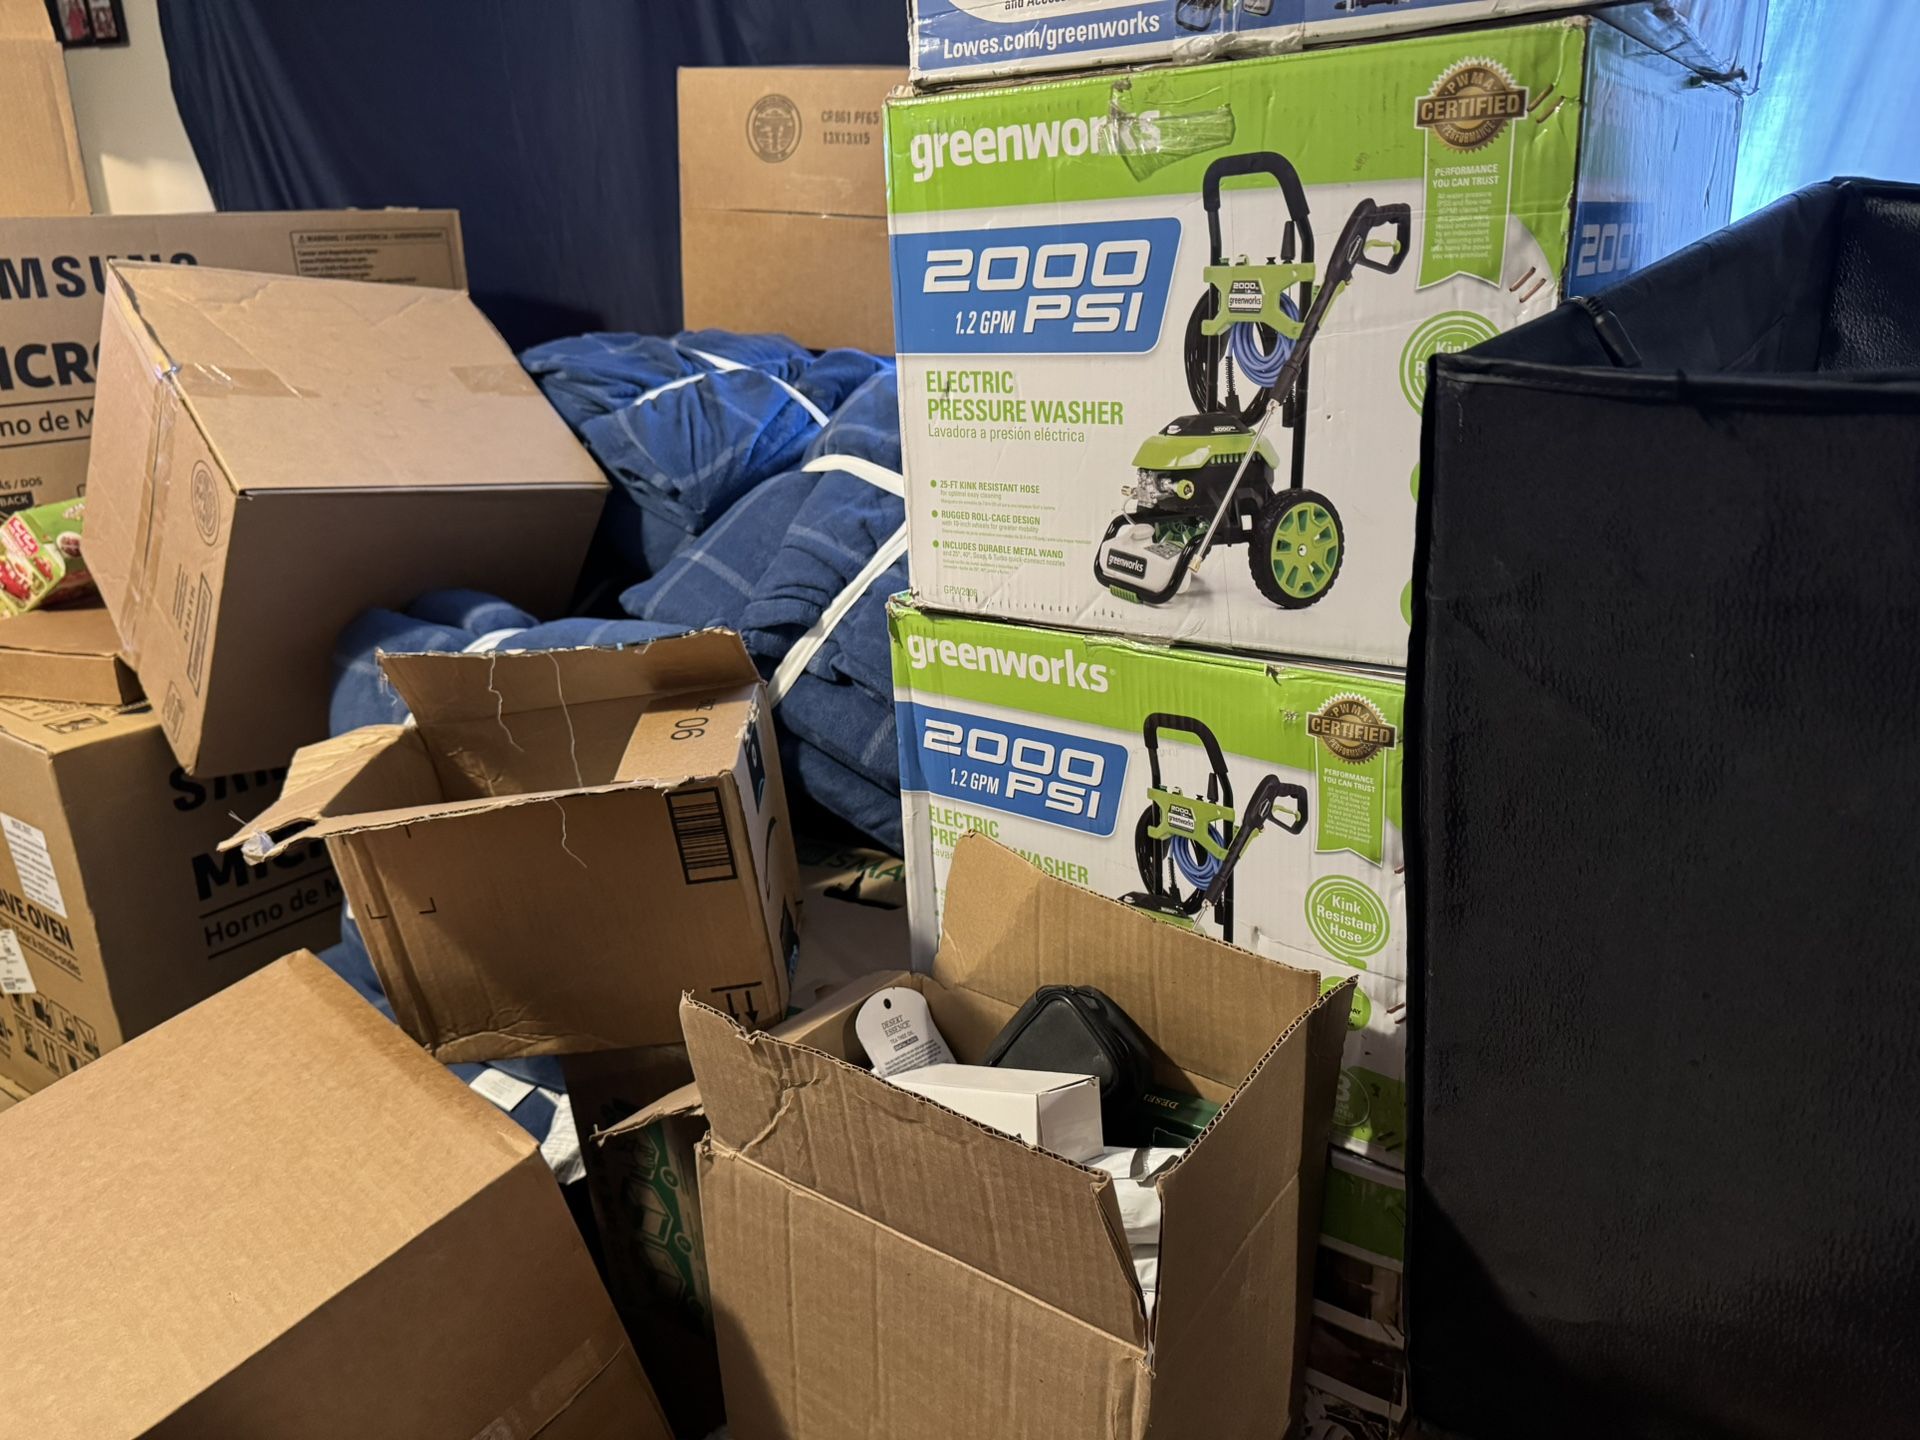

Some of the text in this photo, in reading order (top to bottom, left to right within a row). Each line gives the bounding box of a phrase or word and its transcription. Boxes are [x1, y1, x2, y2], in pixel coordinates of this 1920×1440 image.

[944, 13, 1160, 59] Lowes.com/greenworks
[1447, 71, 1495, 96] PWMA
[1420, 93, 1519, 122] CERTIFIED
[1442, 121, 1496, 144] PERFORMANCE
[909, 110, 1161, 182] greenworks
[1432, 175, 1499, 188] YOU CAN TRUST
[1434, 163, 1499, 177] PERFORMANCE
[923, 239, 1151, 292] 2000
[1023, 292, 1144, 334] PSI
[1229, 296, 1262, 306] greenworks
[955, 310, 1016, 335] 1.2 GPM
[926, 370, 1014, 394] ELECTRIC
[39, 411, 69, 433] de
[927, 398, 1124, 425] PRESSURE WASHER
[928, 424, 1085, 443] Lavadora a presión eléctrica
[21, 478, 43, 488] DOS
[940, 480, 1040, 494] 25-FT KINK RESISTANT HOSE
[941, 510, 1040, 525] RUGGED ROLL-CAGE DESIGN
[942, 540, 1063, 559] INCLUDES DURABLE METAL WAND
[1108, 554, 1144, 573] greenworks
[907, 634, 1109, 693] greenworks
[1332, 701, 1371, 723] PWMA
[1310, 716, 1390, 745] CERTIFIED
[923, 718, 1105, 787] 2000
[950, 767, 1000, 795] 1.2 GPM
[1322, 776, 1376, 793] YOU CAN TRUST
[1324, 768, 1375, 785] PERFORMANCE
[1005, 771, 1100, 819] PSI
[928, 803, 1000, 839] ELECTRIC
[204, 903, 284, 948] Horno
[290, 886, 321, 914] de
[1332, 894, 1361, 916] Kink
[27, 904, 75, 951] OVEN
[1316, 904, 1378, 935] Resistant
[1329, 924, 1363, 944] Hose
[881, 1015, 904, 1030] DESERT
